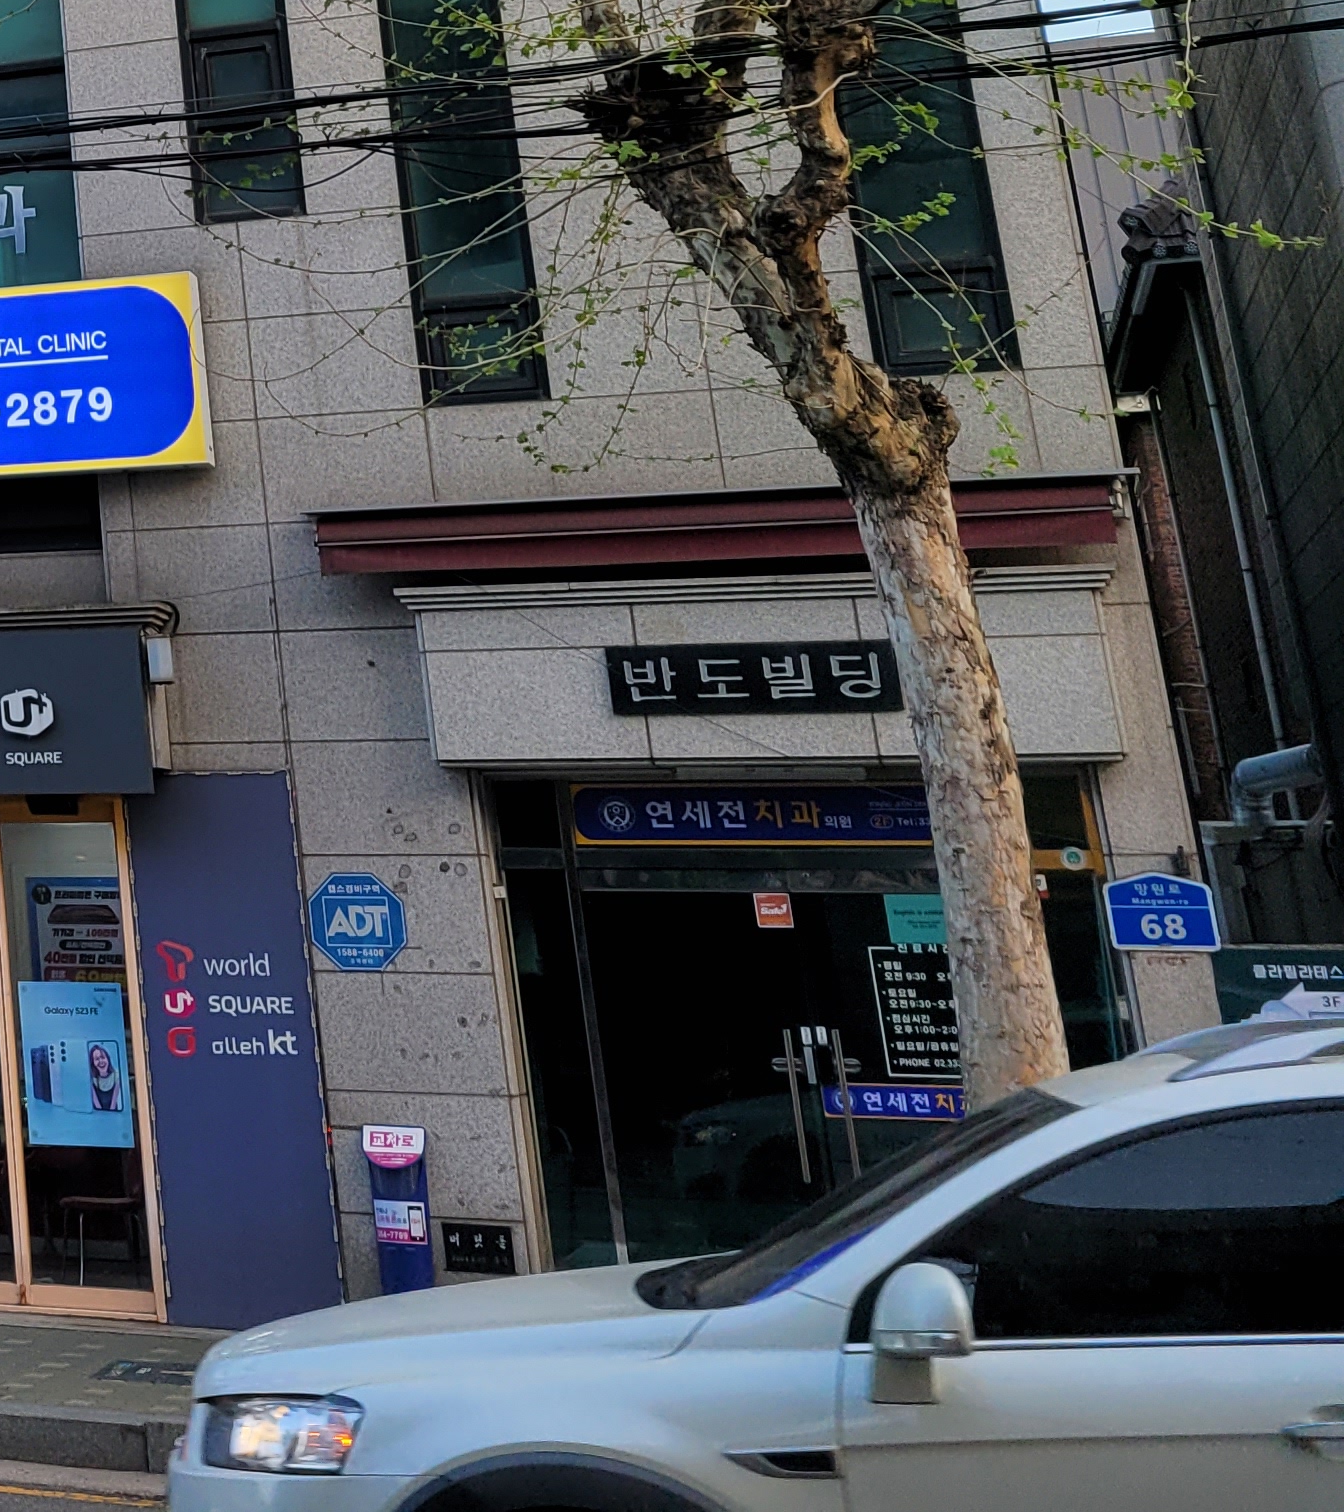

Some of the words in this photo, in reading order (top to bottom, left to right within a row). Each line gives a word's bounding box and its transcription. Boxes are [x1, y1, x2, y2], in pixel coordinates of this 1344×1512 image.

[37, 330, 107, 353] CLINIC
[623, 651, 883, 703] 반도빌딩
[5, 751, 63, 767] SQUARE
[824, 815, 853, 829] 의원
[1133, 883, 1182, 897] 망원로
[327, 905, 388, 938] ADT
[1140, 913, 1188, 940] 68
[203, 952, 271, 977] world
[208, 995, 295, 1017] SQUARE
[1322, 995, 1341, 1008] 3F
[44, 1006, 74, 1017] Galaxy
[212, 1036, 265, 1056] olleh
[268, 1029, 299, 1056] kt
[899, 1058, 931, 1067] PHONE
[370, 1131, 415, 1148] 교차로
